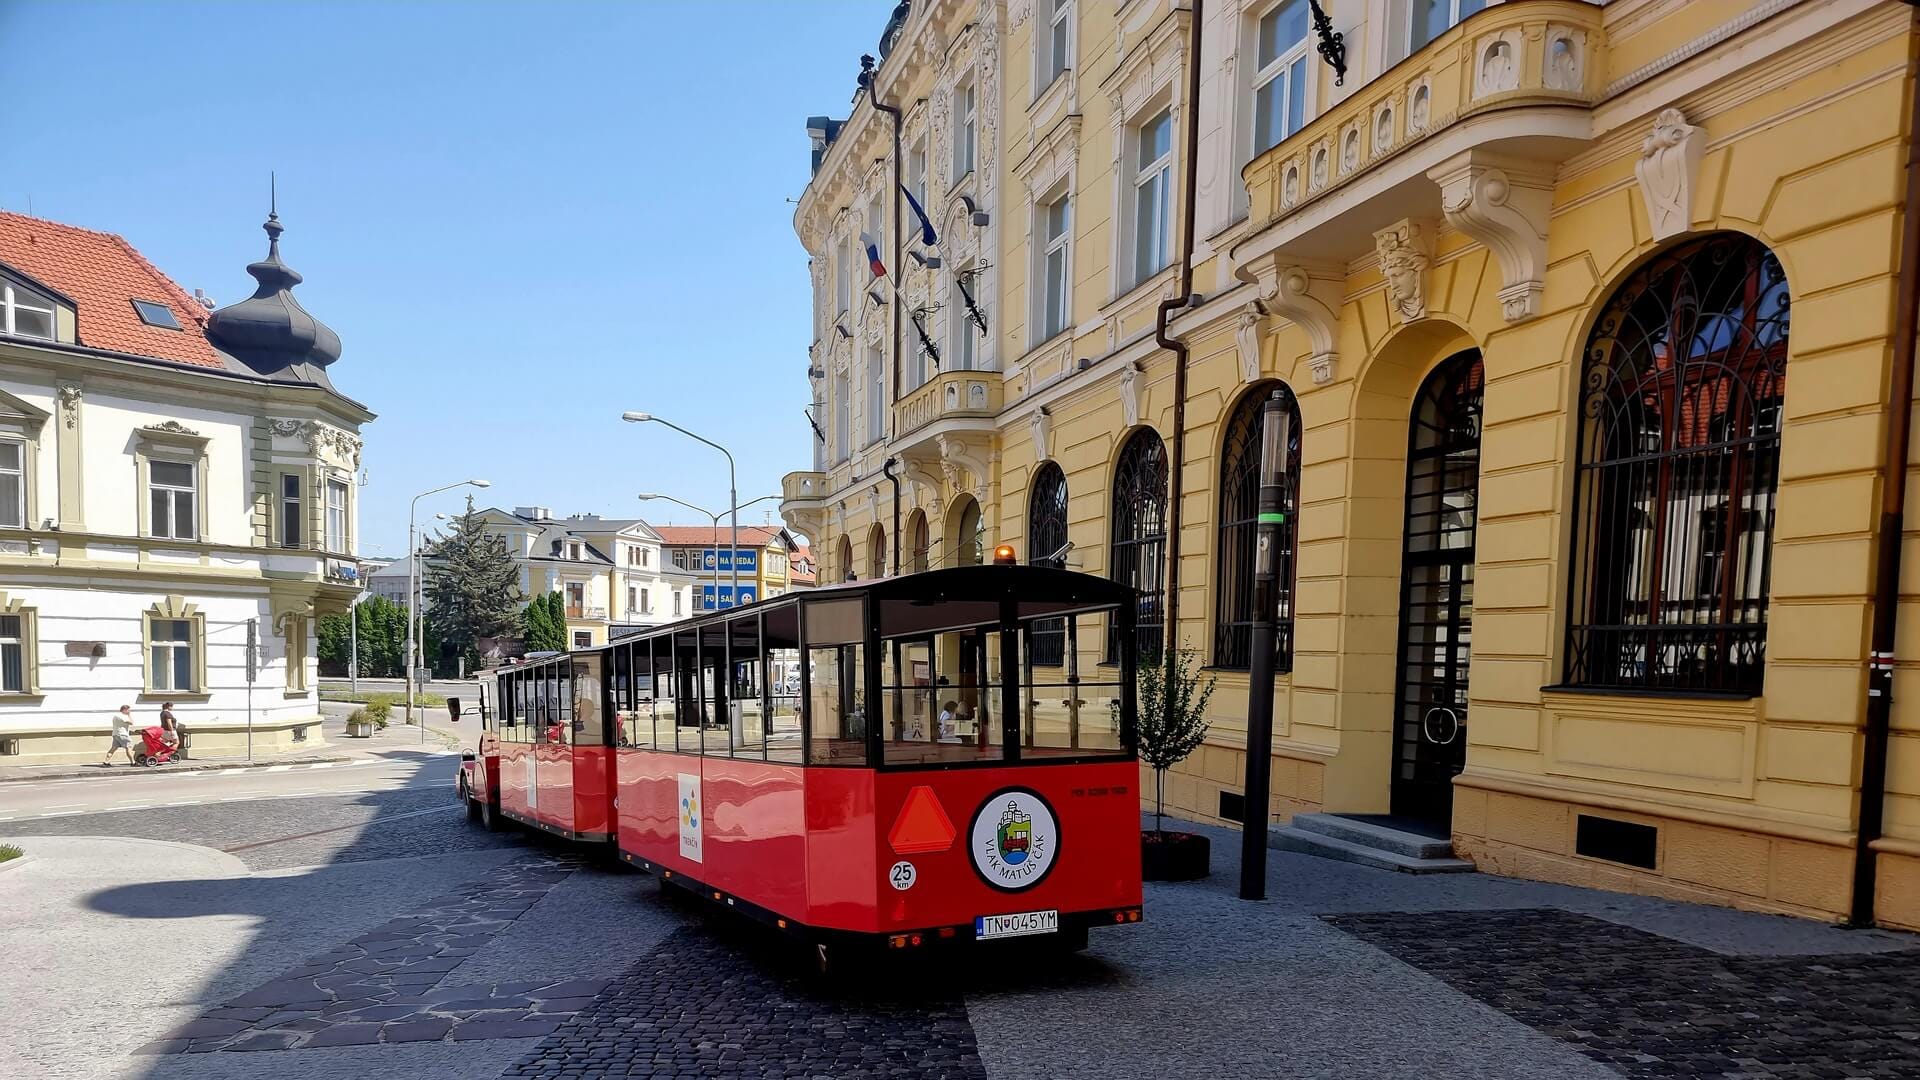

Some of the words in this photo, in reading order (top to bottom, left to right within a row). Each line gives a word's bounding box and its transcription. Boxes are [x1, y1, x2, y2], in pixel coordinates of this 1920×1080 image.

[720, 557, 729, 565] NA
[705, 594, 716, 602] FO
[720, 595, 733, 603] SAL
[985, 838, 1001, 870] VLAK
[999, 860, 1037, 880] MATÚŠ
[1031, 834, 1044, 860] ČÁK
[893, 864, 912, 881] 25
[896, 880, 909, 889] km
